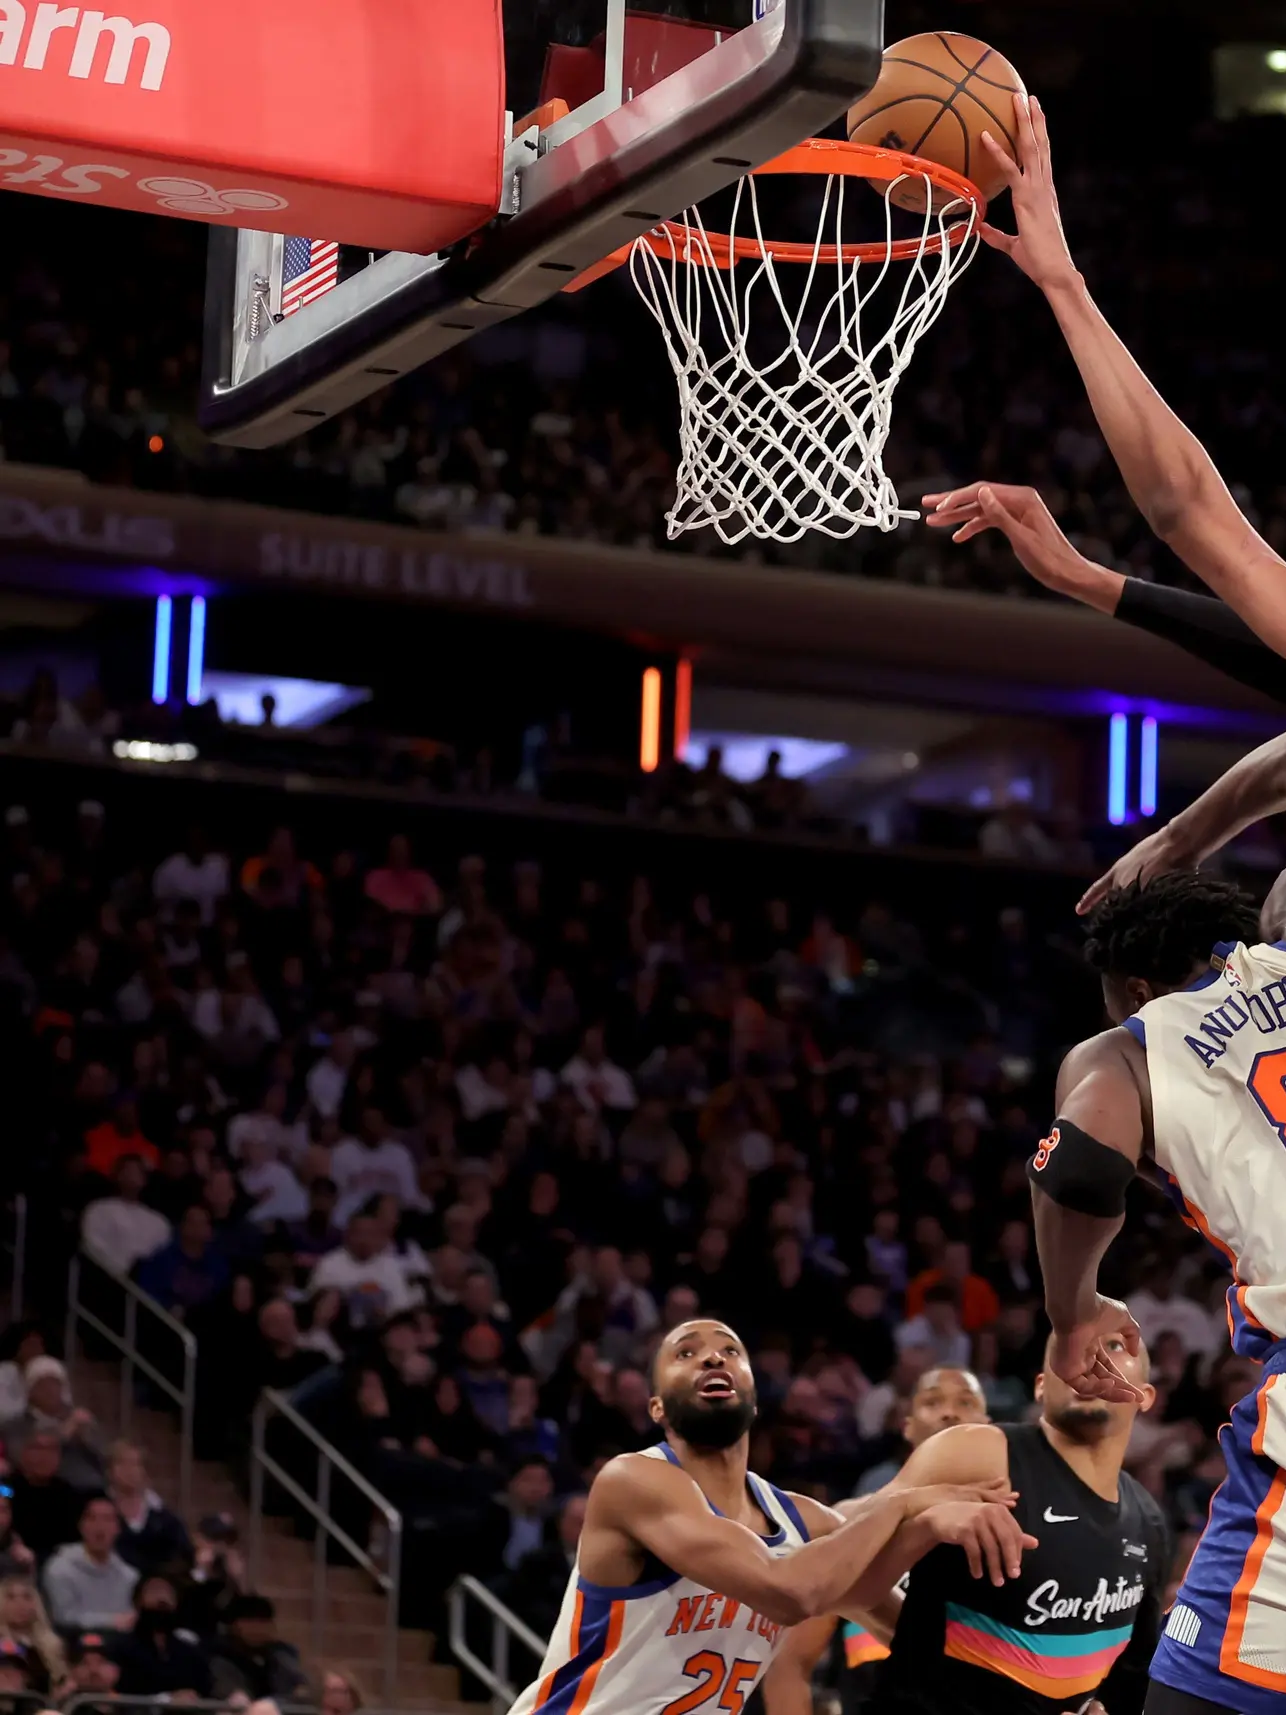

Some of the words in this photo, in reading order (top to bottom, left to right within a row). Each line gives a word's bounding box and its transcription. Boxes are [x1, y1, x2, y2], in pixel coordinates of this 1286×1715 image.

[0, 0, 171, 91] arm
[259, 531, 388, 588] SUITE
[400, 550, 533, 606] LEVEL
[665, 1592, 742, 1636] NEW
[1023, 1578, 1083, 1627] San
[660, 1649, 762, 1715] 25
